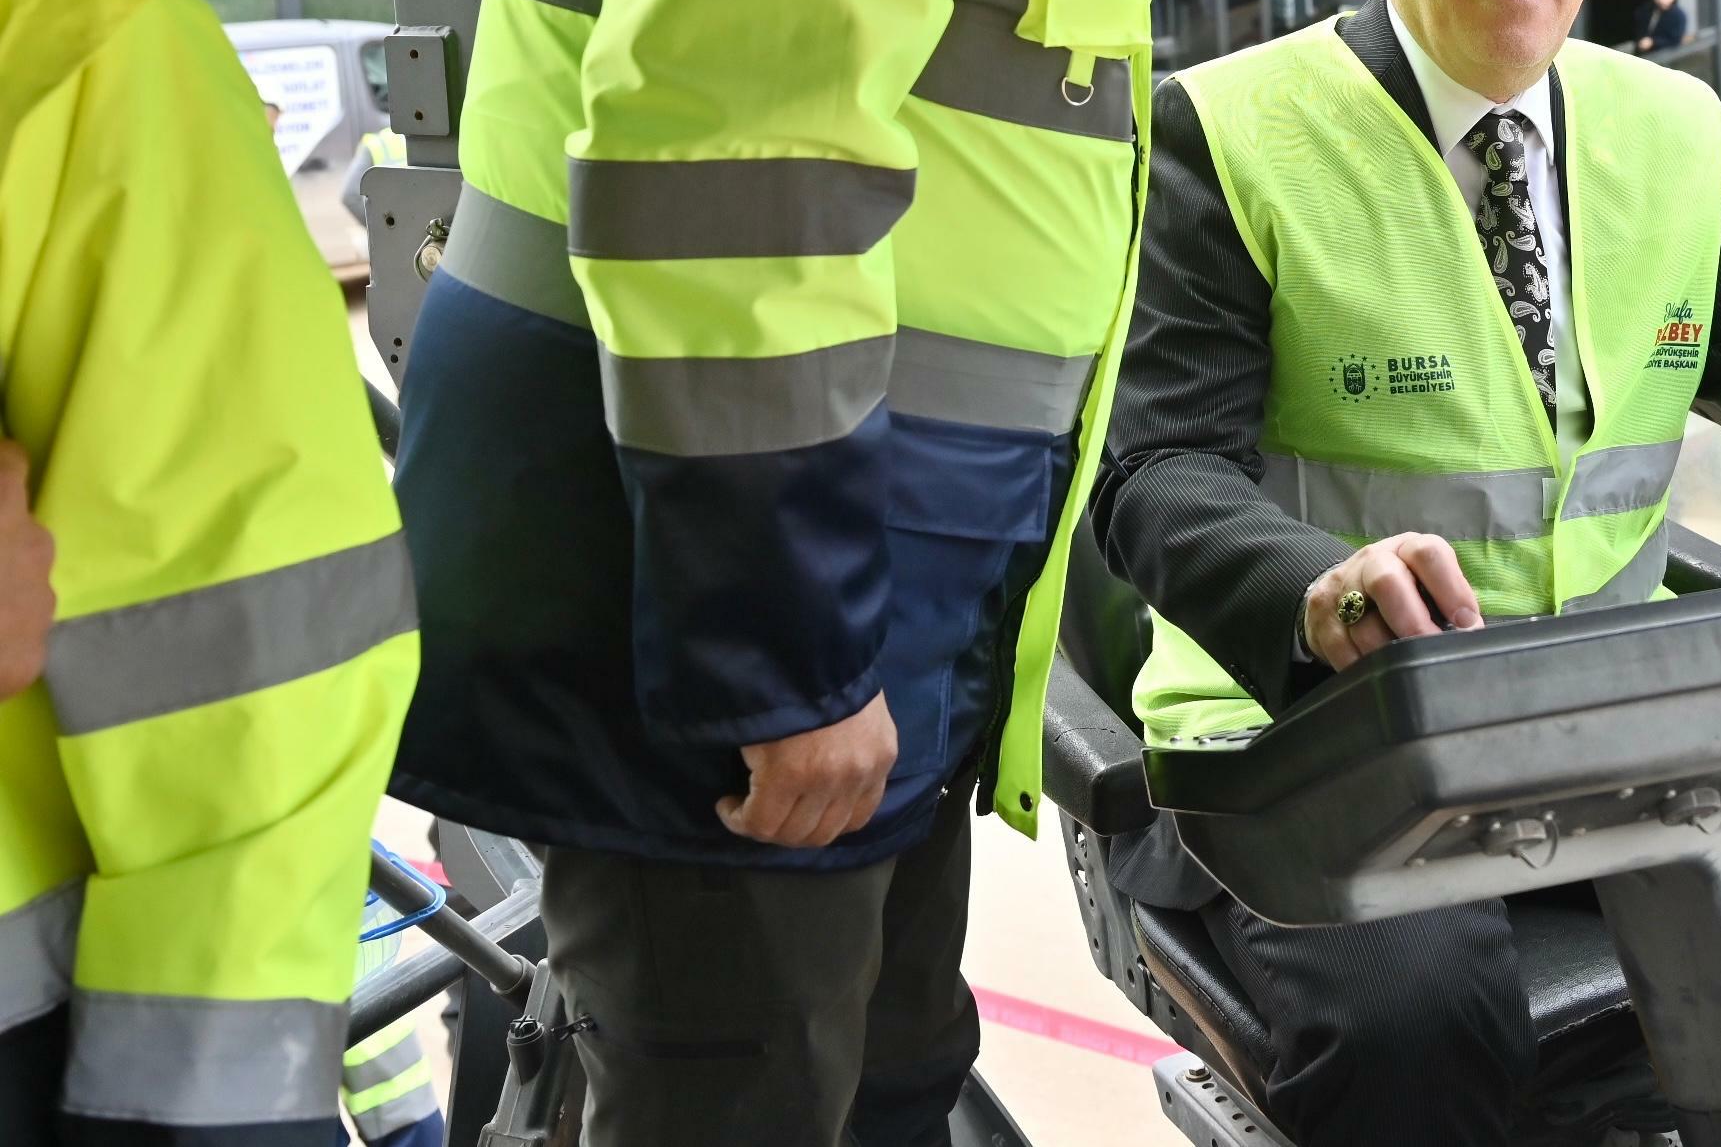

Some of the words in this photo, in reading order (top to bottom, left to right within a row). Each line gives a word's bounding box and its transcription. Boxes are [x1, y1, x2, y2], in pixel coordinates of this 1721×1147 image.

[1387, 354, 1450, 372] BURSA
[1664, 360, 1698, 370] BAŞKANI
[1389, 368, 1452, 383] BÜYÜKŞEHİR
[1390, 380, 1455, 394] BELEDİYESİ
